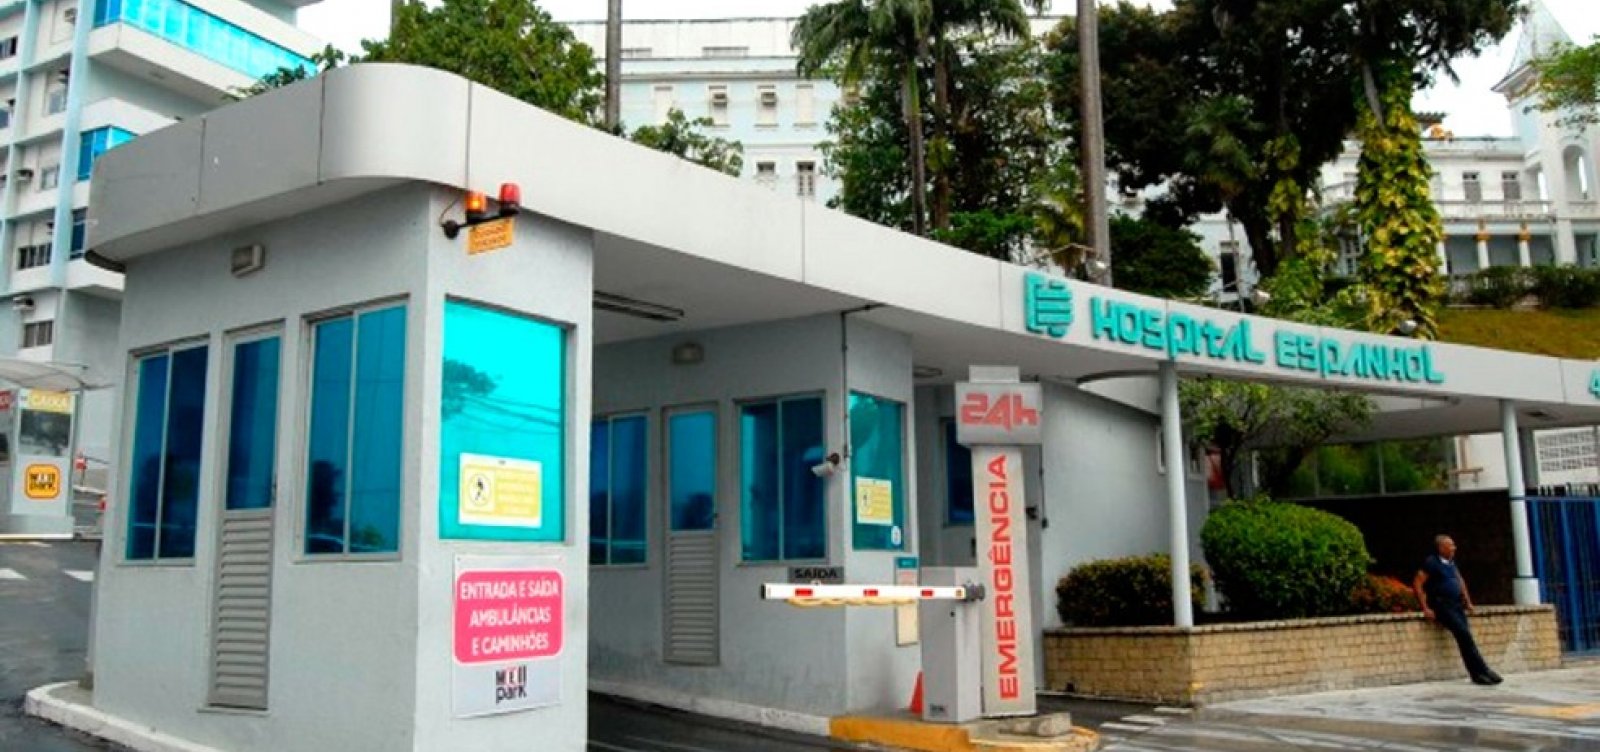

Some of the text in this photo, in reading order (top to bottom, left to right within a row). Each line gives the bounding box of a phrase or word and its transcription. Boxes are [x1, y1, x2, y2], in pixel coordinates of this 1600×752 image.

[1274, 330, 1445, 384] ESPANHOL
[960, 392, 1040, 432] 24h
[461, 578, 559, 600] ENTRADA E SAÍDA
[986, 454, 1020, 701] EMERGÊNCIA
[470, 603, 551, 627] AMBULÂNCIAS
[472, 631, 549, 656] E CAMINHÕES
